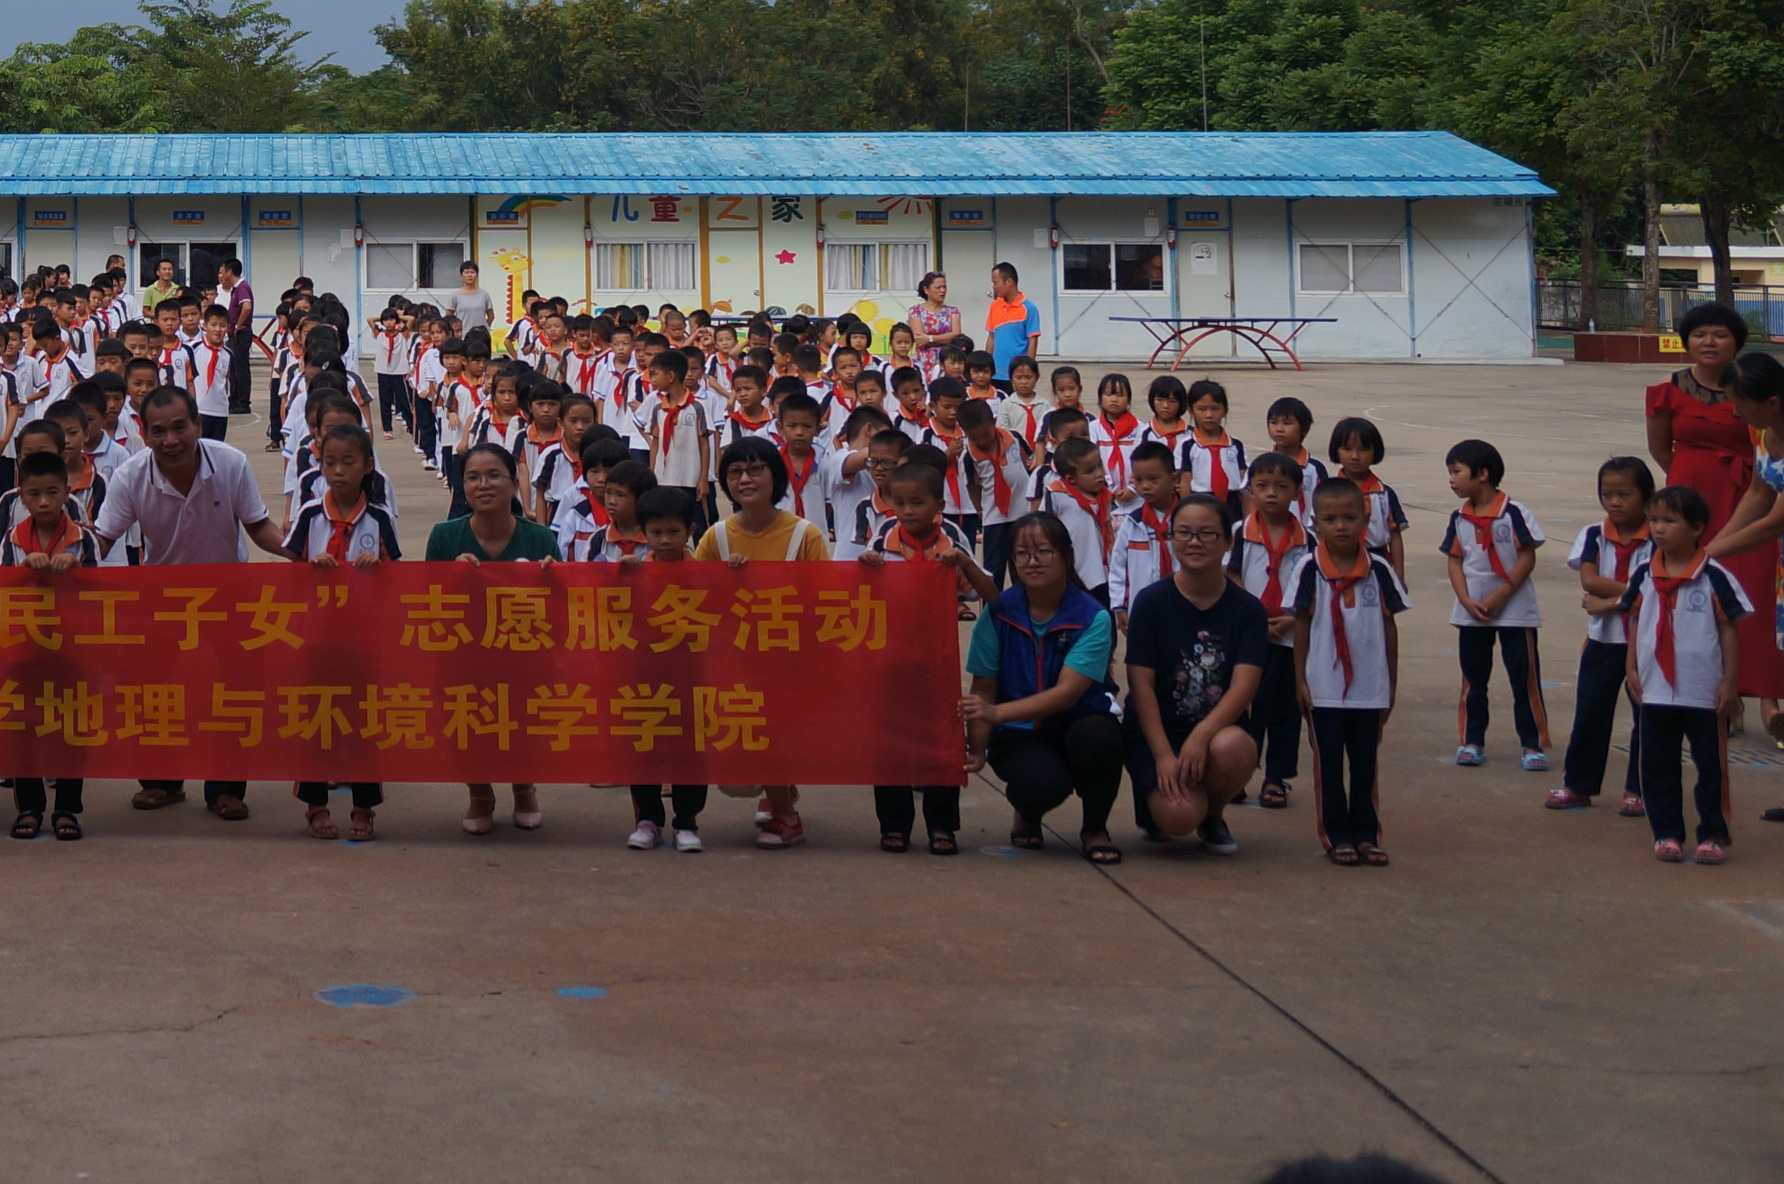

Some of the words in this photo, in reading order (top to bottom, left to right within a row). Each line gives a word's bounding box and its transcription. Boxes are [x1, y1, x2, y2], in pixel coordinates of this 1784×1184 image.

[611, 195, 804, 223] 儿童之家
[1662, 338, 1685, 349] 禁止
[398, 583, 890, 653] 志愿服务活动
